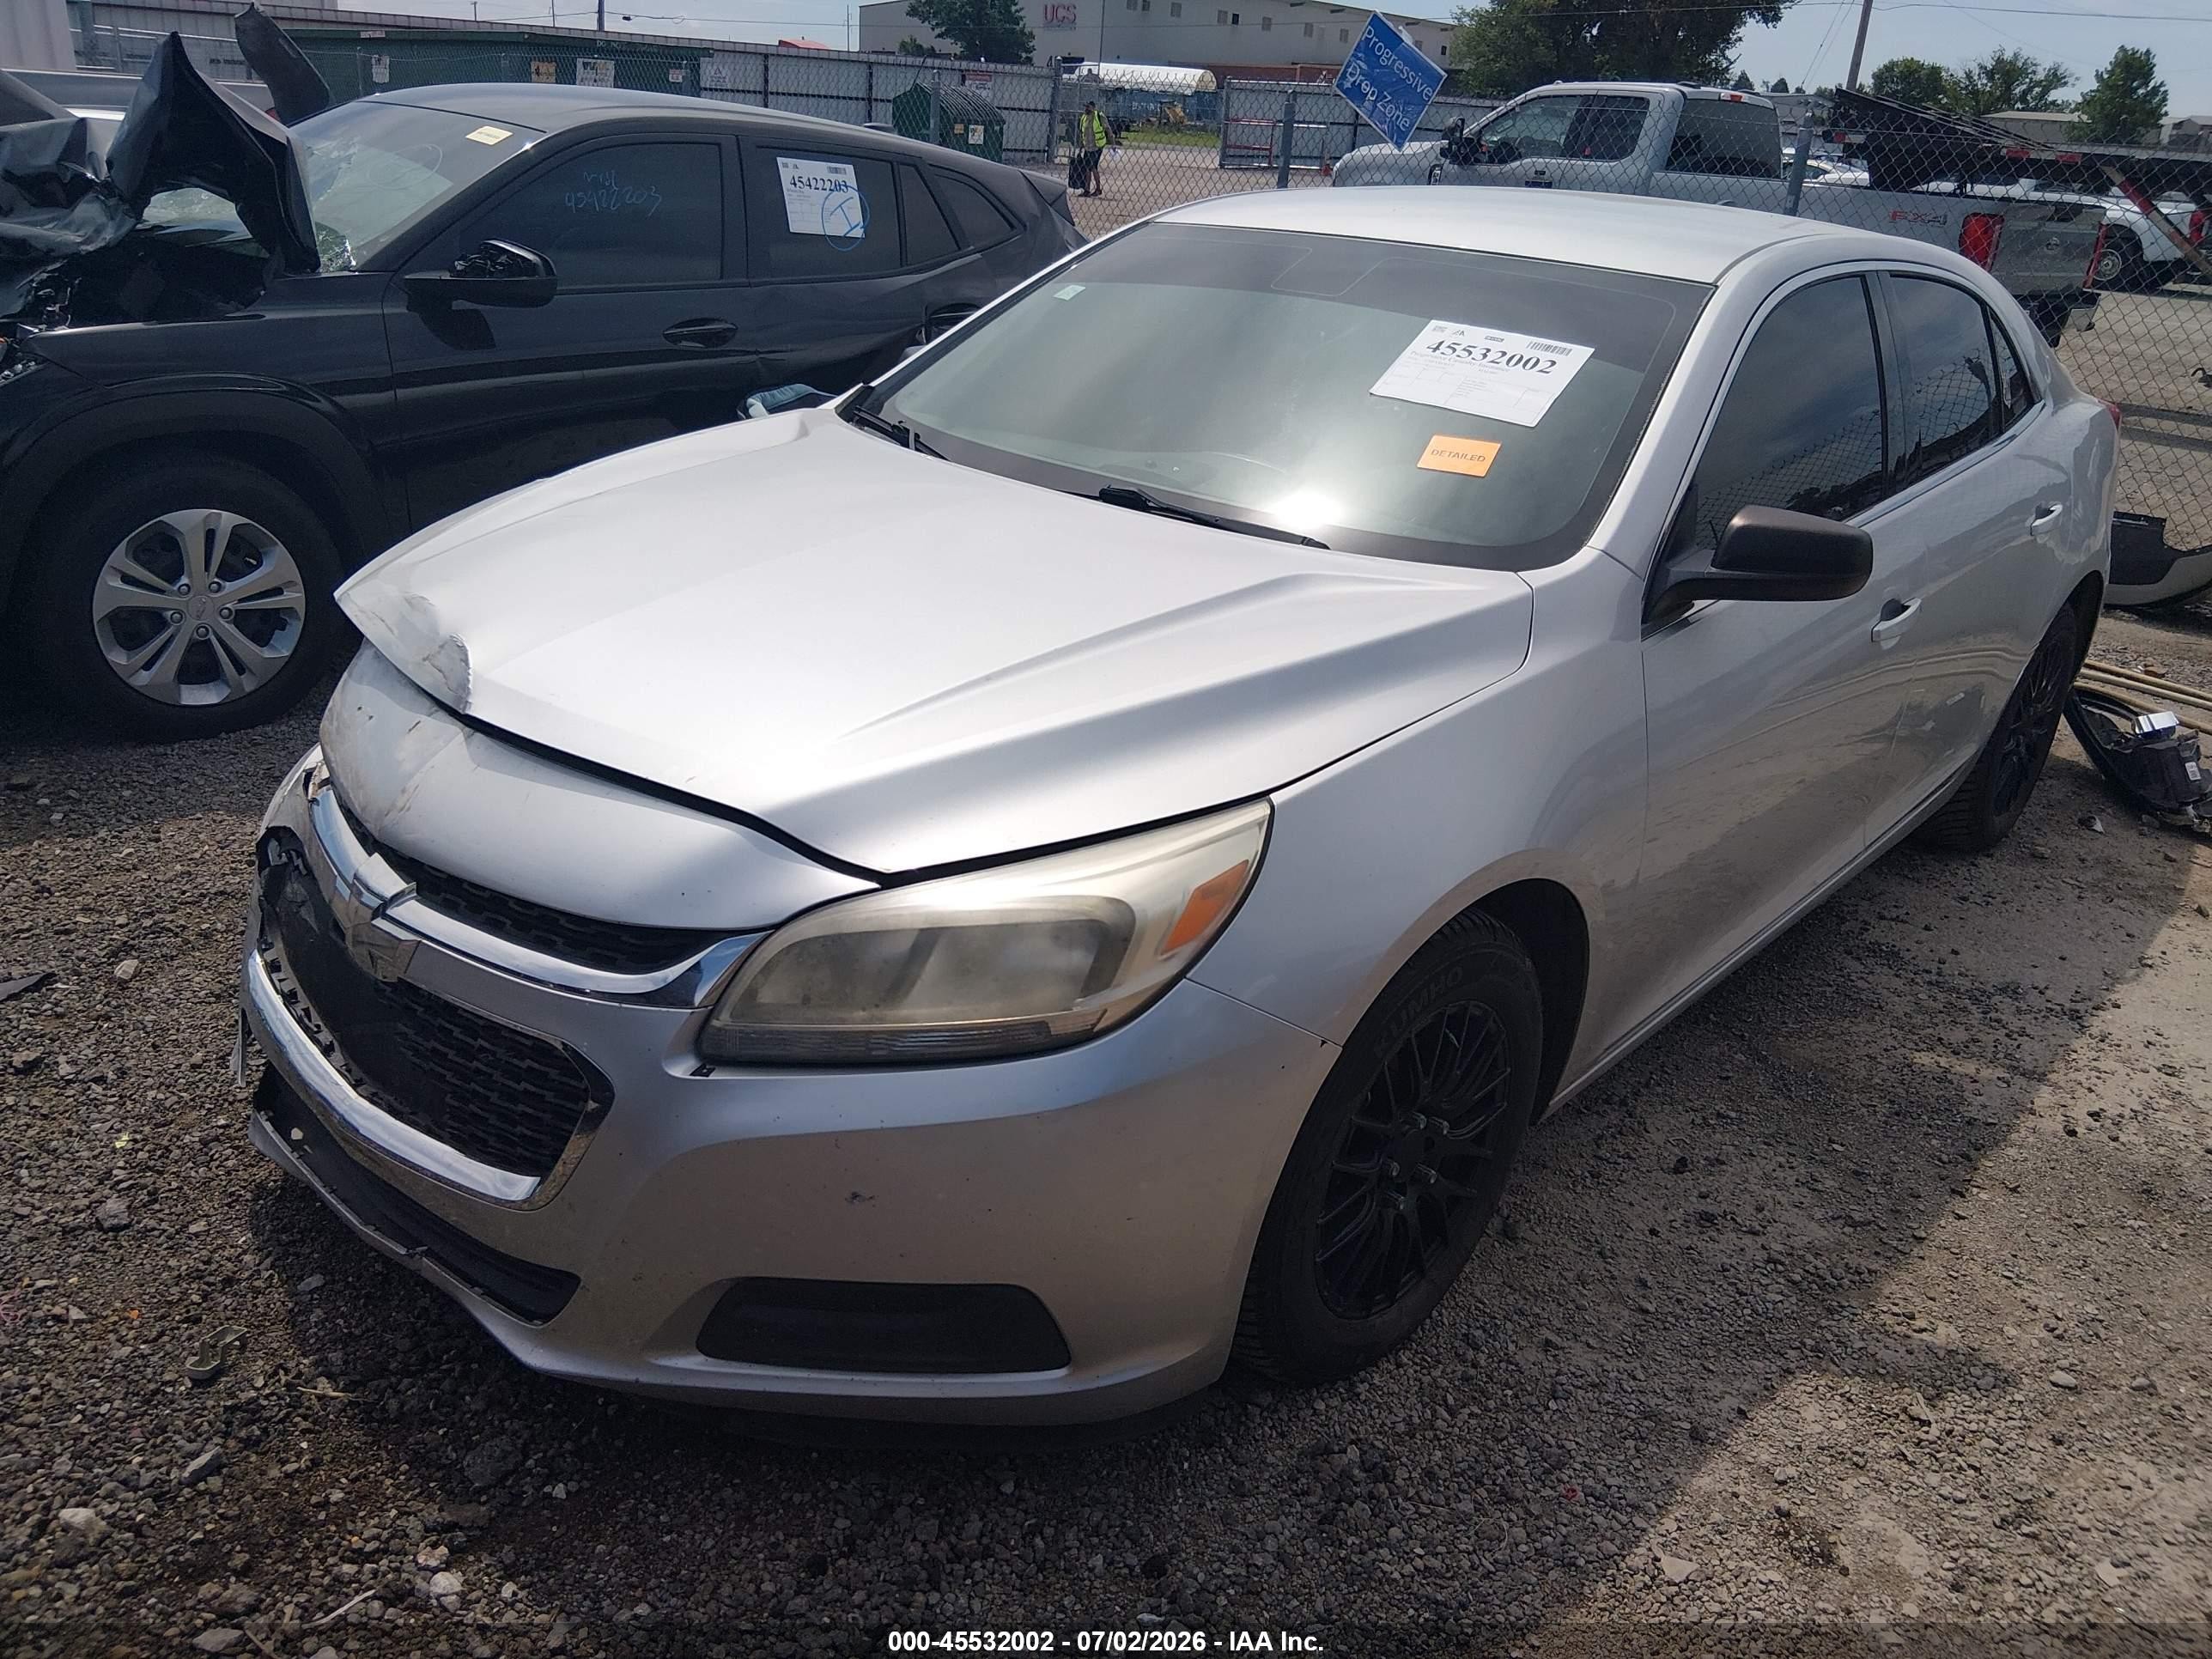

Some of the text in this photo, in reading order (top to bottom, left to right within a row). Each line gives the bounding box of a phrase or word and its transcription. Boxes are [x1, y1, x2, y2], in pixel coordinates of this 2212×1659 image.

[1044, 4, 1077, 24] UCS
[1362, 25, 1433, 101] Progressive
[1346, 61, 1410, 131] Drop Zone
[790, 174, 849, 193] 45422203
[1426, 340, 1557, 374] 45532002
[1431, 449, 1486, 462] DETAILED
